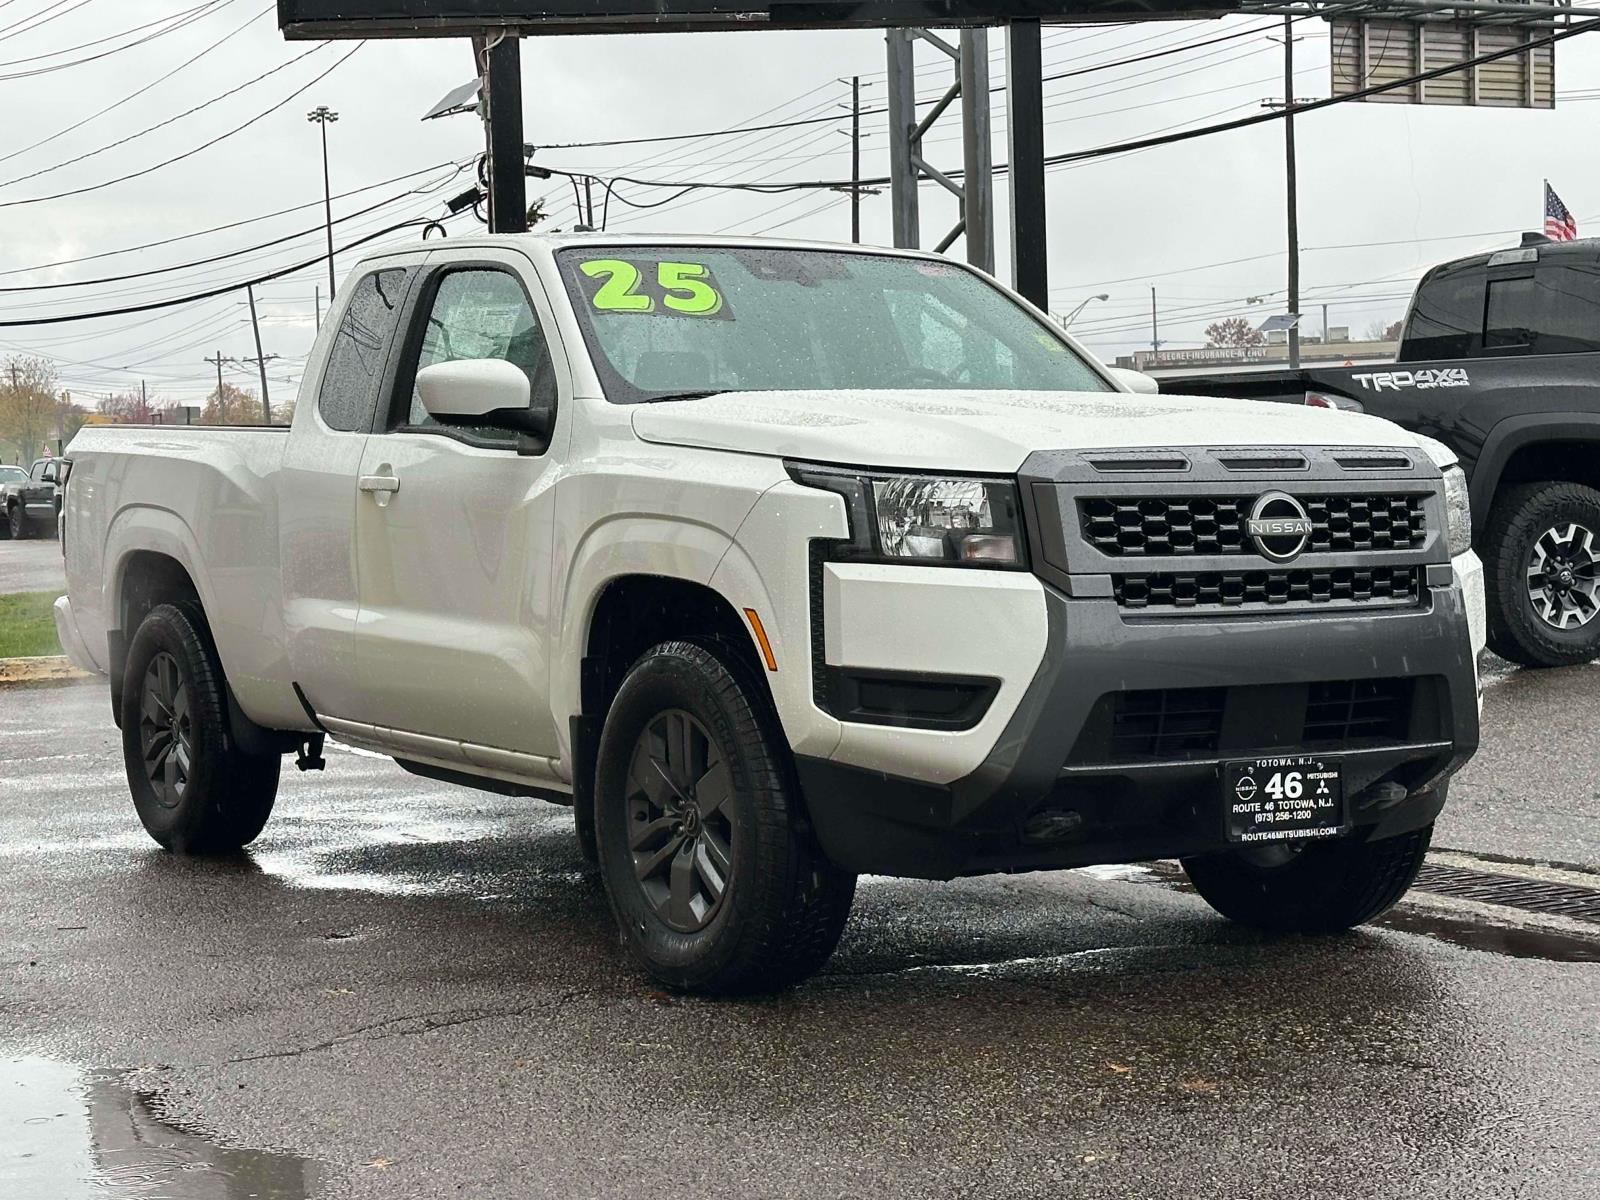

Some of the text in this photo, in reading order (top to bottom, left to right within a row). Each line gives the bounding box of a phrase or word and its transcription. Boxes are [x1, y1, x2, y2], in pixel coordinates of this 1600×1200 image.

[579, 259, 722, 316] 25
[1250, 522, 1313, 533] NISSAN
[1307, 771, 1338, 780] MITSUBISHI
[1264, 771, 1303, 799] 46
[1232, 798, 1334, 813] ROUTE 46 TOTOWA, N.J.
[1255, 810, 1311, 824] (973) 256-1200
